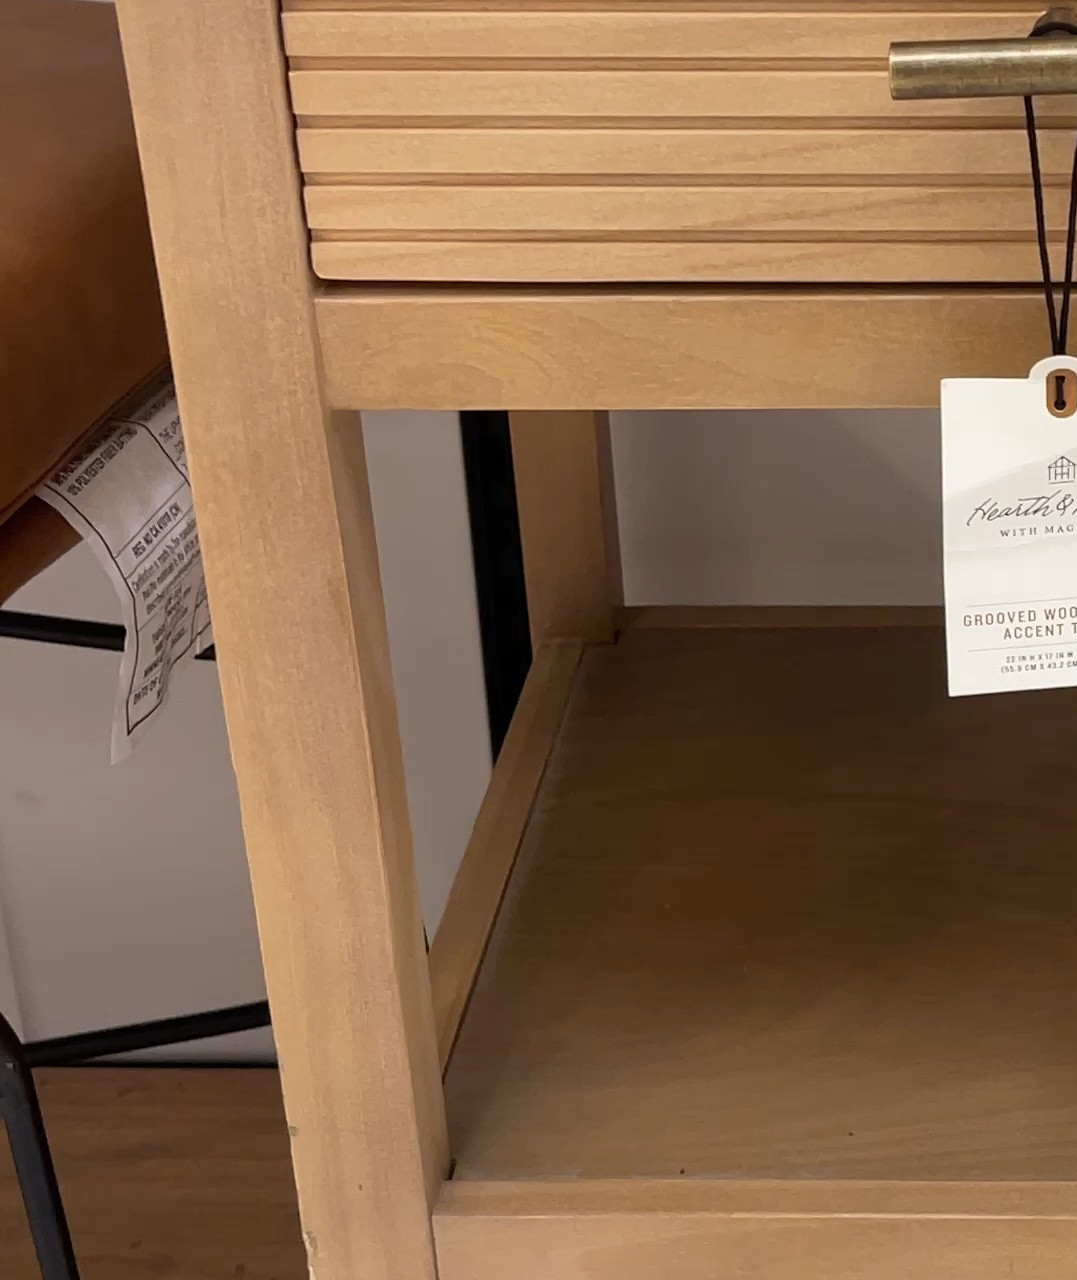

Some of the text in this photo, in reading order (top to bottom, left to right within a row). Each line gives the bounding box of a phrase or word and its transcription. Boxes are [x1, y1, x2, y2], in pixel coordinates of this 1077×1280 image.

[966, 489, 1062, 526] Hearth
[1056, 493, 1074, 516] &
[1000, 526, 1038, 538] WITH
[963, 609, 1037, 627] GROOVED
[1003, 623, 1064, 640] ACCENT
